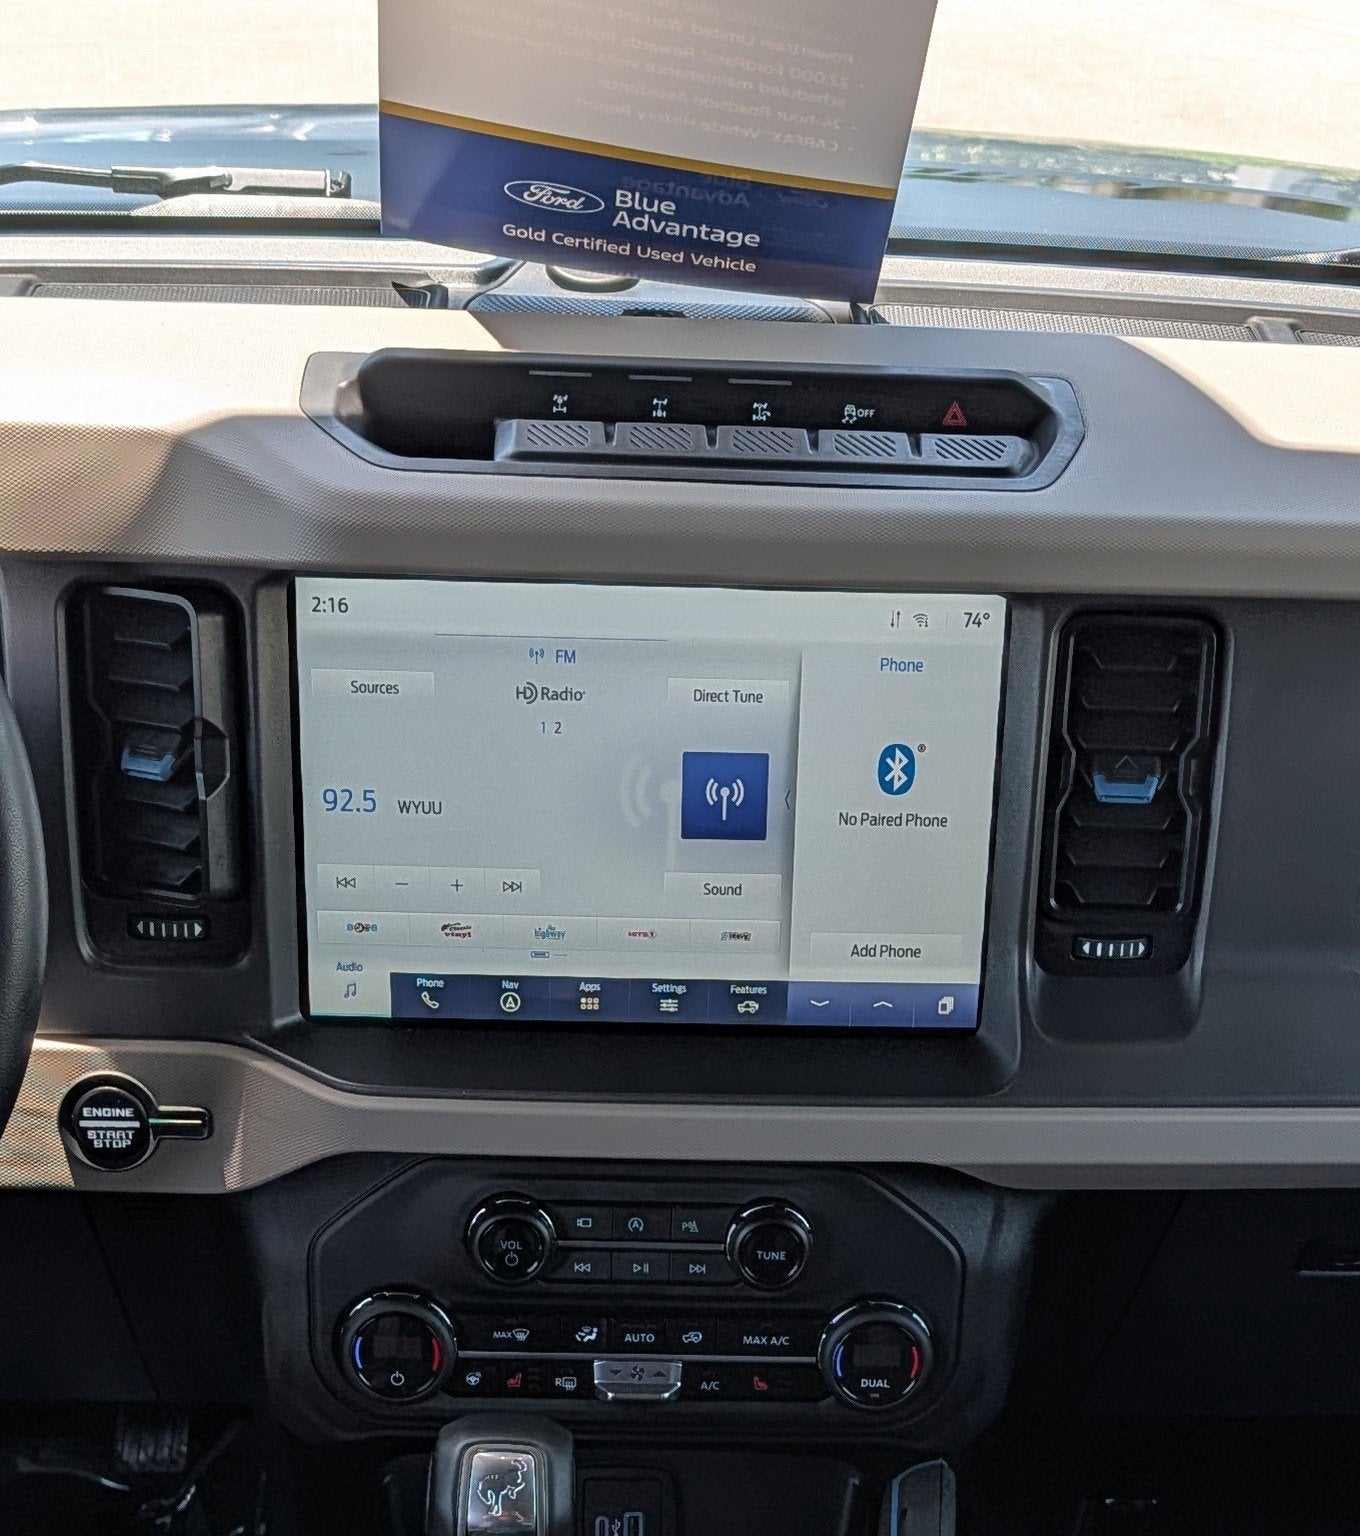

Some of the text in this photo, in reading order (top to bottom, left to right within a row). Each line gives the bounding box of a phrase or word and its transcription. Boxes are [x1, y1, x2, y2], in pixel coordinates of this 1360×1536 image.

[523, 184, 584, 210] Ford
[615, 190, 676, 215] Blue
[612, 211, 761, 247] Advantage
[503, 224, 756, 272] Gold Certified Used Vehicle
[857, 407, 875, 419] OFF
[311, 596, 349, 614] 2:16
[963, 612, 991, 628] 74°
[555, 649, 577, 664] FM
[880, 657, 924, 672] Phone
[350, 680, 400, 695] Sources
[541, 686, 585, 702] Radio
[693, 688, 763, 704] Direct Tune
[540, 721, 547, 735] 1
[553, 721, 562, 735] 2
[322, 788, 377, 813] 92.5
[397, 799, 443, 815] WYUU
[838, 812, 948, 828] No Paired Phone
[703, 882, 742, 896] Sound
[850, 944, 922, 959] Add Phone
[336, 961, 363, 972] Audio
[416, 977, 444, 988] Phone
[502, 979, 520, 990] Nav
[579, 981, 601, 993] Apps
[651, 982, 687, 995] Settings
[730, 984, 768, 995] Features
[82, 1107, 135, 1118] ENGINE
[87, 1130, 135, 1140] START
[93, 1139, 133, 1149] STOP
[500, 1240, 523, 1251] VOL
[756, 1250, 787, 1261] TUNE
[492, 1331, 512, 1339] MAX
[624, 1332, 655, 1343] AUTO
[742, 1334, 790, 1347] MAX A/C
[700, 1380, 720, 1392] A/C
[860, 1378, 890, 1389] DUAL
